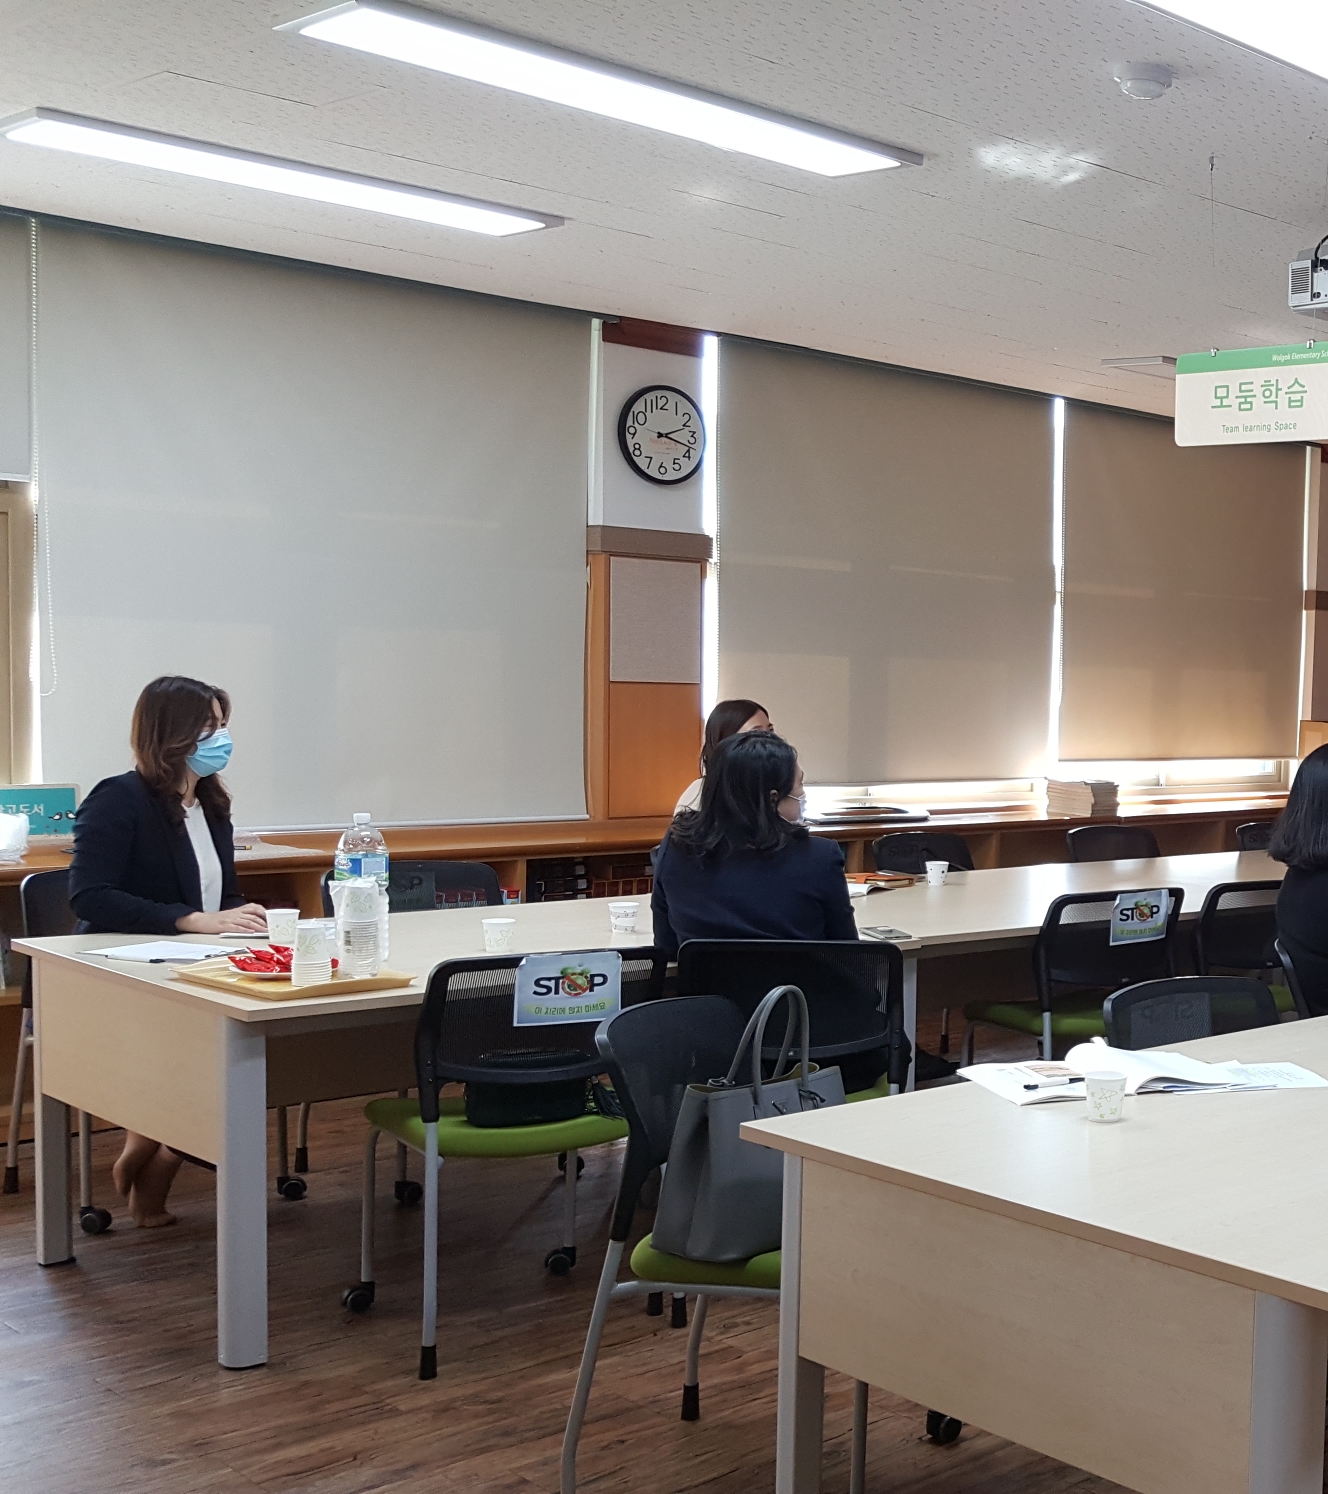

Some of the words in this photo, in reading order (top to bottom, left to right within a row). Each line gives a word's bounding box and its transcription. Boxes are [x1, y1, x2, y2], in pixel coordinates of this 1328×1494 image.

[1292, 351, 1320, 360] Elementary
[1211, 377, 1307, 411] 모둠학습
[645, 398, 653, 413] 11
[655, 395, 669, 411] 12
[675, 401, 678, 416] 1
[632, 410, 647, 426] 10
[682, 412, 691, 428] 2
[627, 425, 637, 440] 9
[1222, 424, 1239, 433] Team
[1242, 422, 1271, 433] learning
[1274, 421, 1297, 431] Space
[687, 430, 697, 445] 3
[632, 442, 642, 457] 8
[682, 447, 691, 461] 4
[644, 456, 653, 470] 7
[658, 461, 667, 475] 6
[672, 458, 682, 472] 5
[1119, 904, 1160, 922] STOP
[532, 972, 608, 997] STOP
[534, 1006, 542, 1015] 이
[545, 1006, 566, 1015] 자리에
